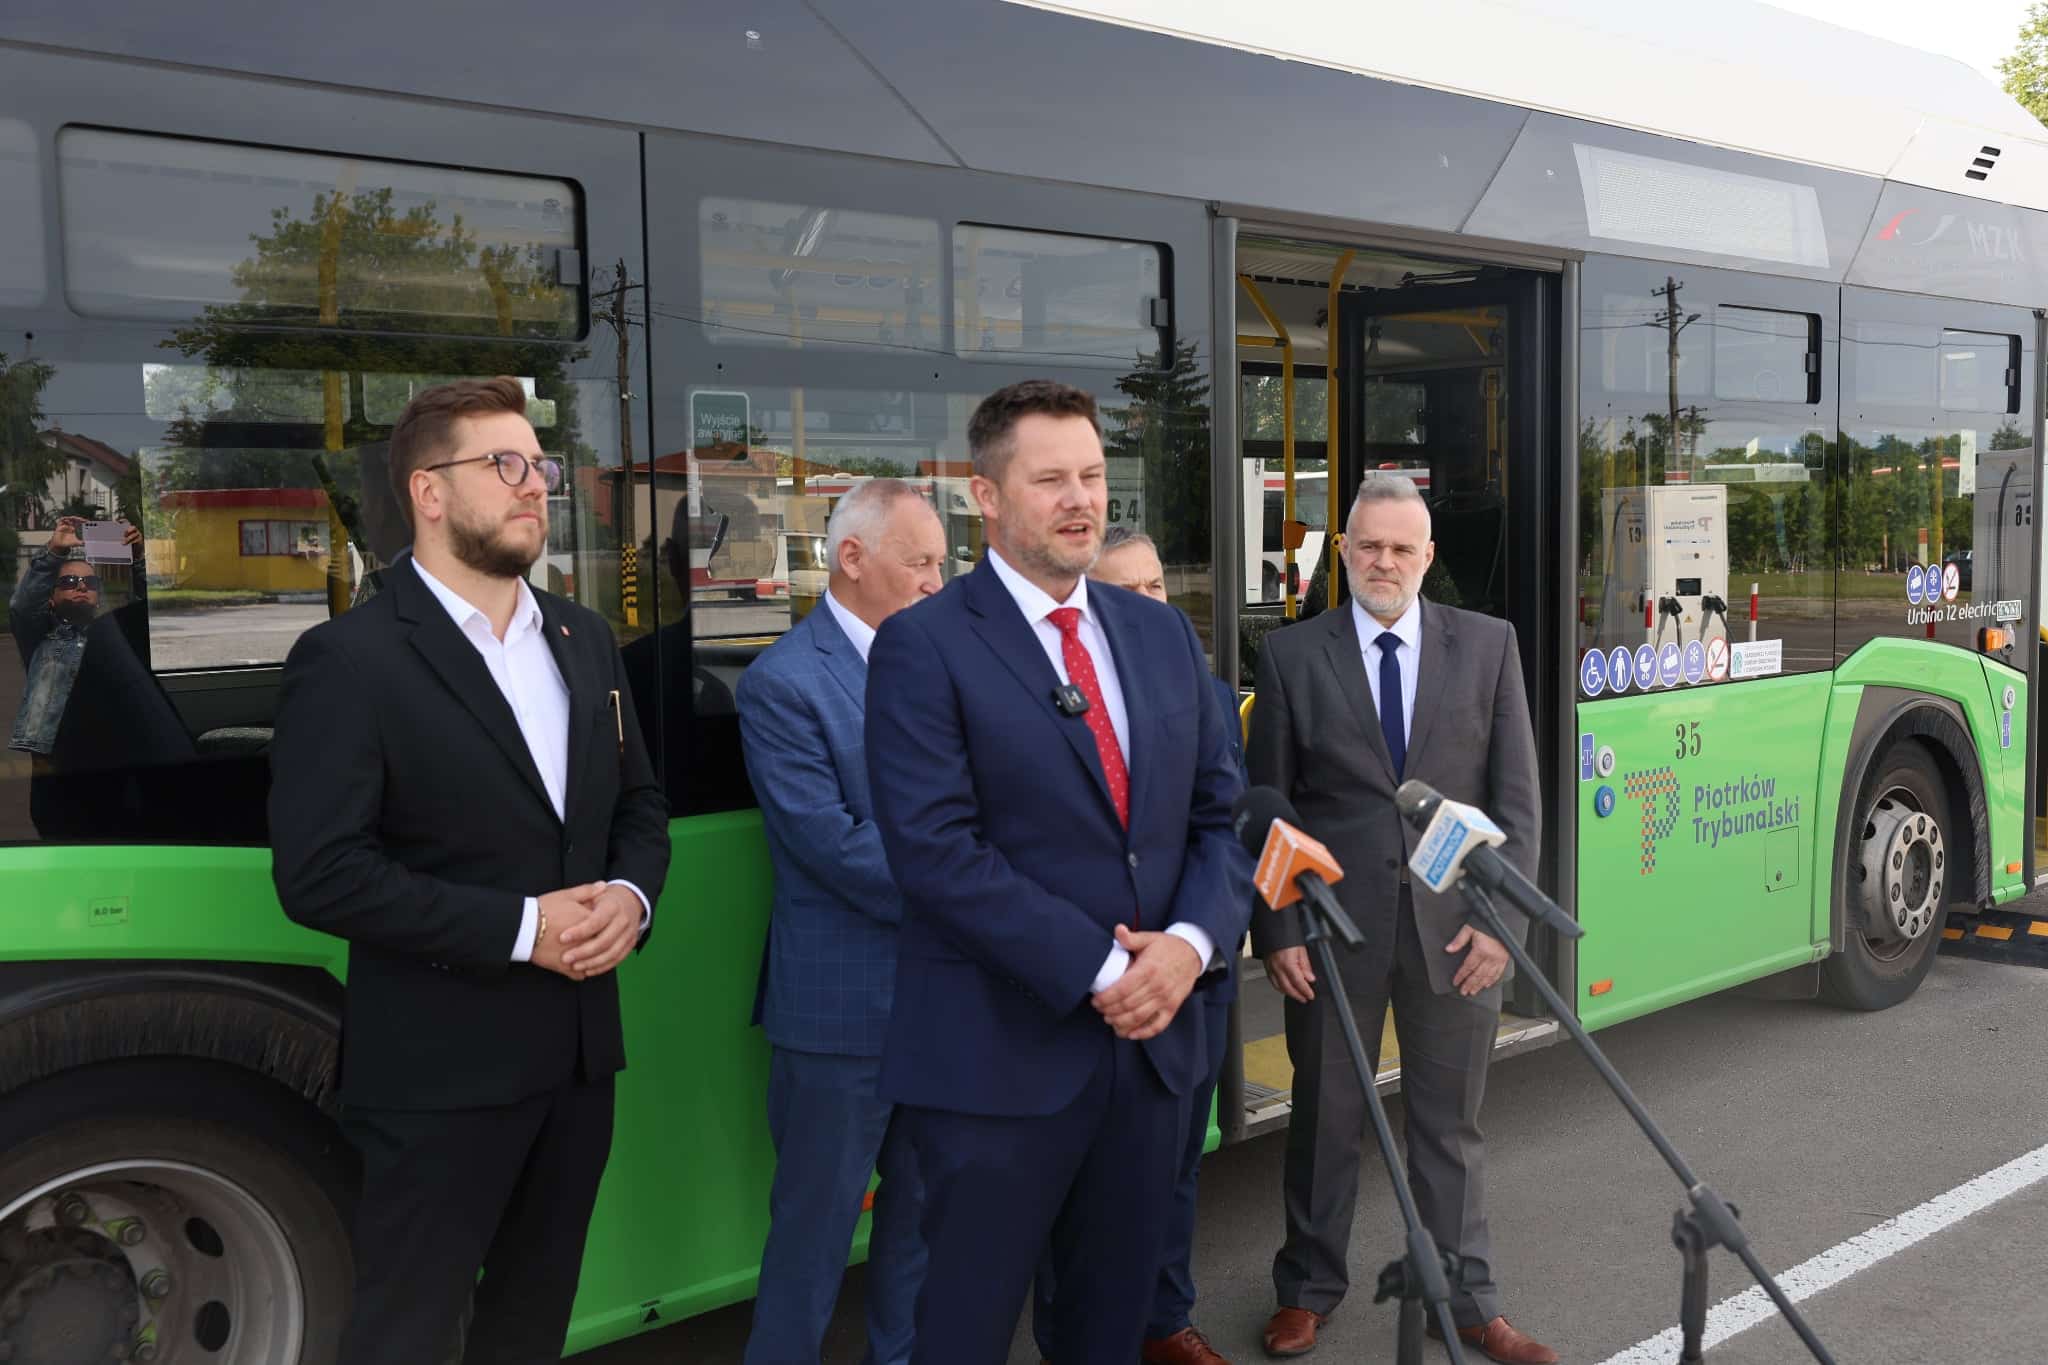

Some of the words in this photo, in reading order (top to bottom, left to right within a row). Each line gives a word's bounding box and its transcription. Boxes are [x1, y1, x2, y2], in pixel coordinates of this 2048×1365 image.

[1967, 221, 2025, 264] MZK
[1907, 606, 1944, 625] Urbino
[1946, 604, 1957, 621] 12
[1958, 600, 1997, 620] electric
[1675, 721, 1702, 759] 35
[1694, 773, 1776, 813] Piotrków
[1692, 795, 1800, 848] Trybunalski
